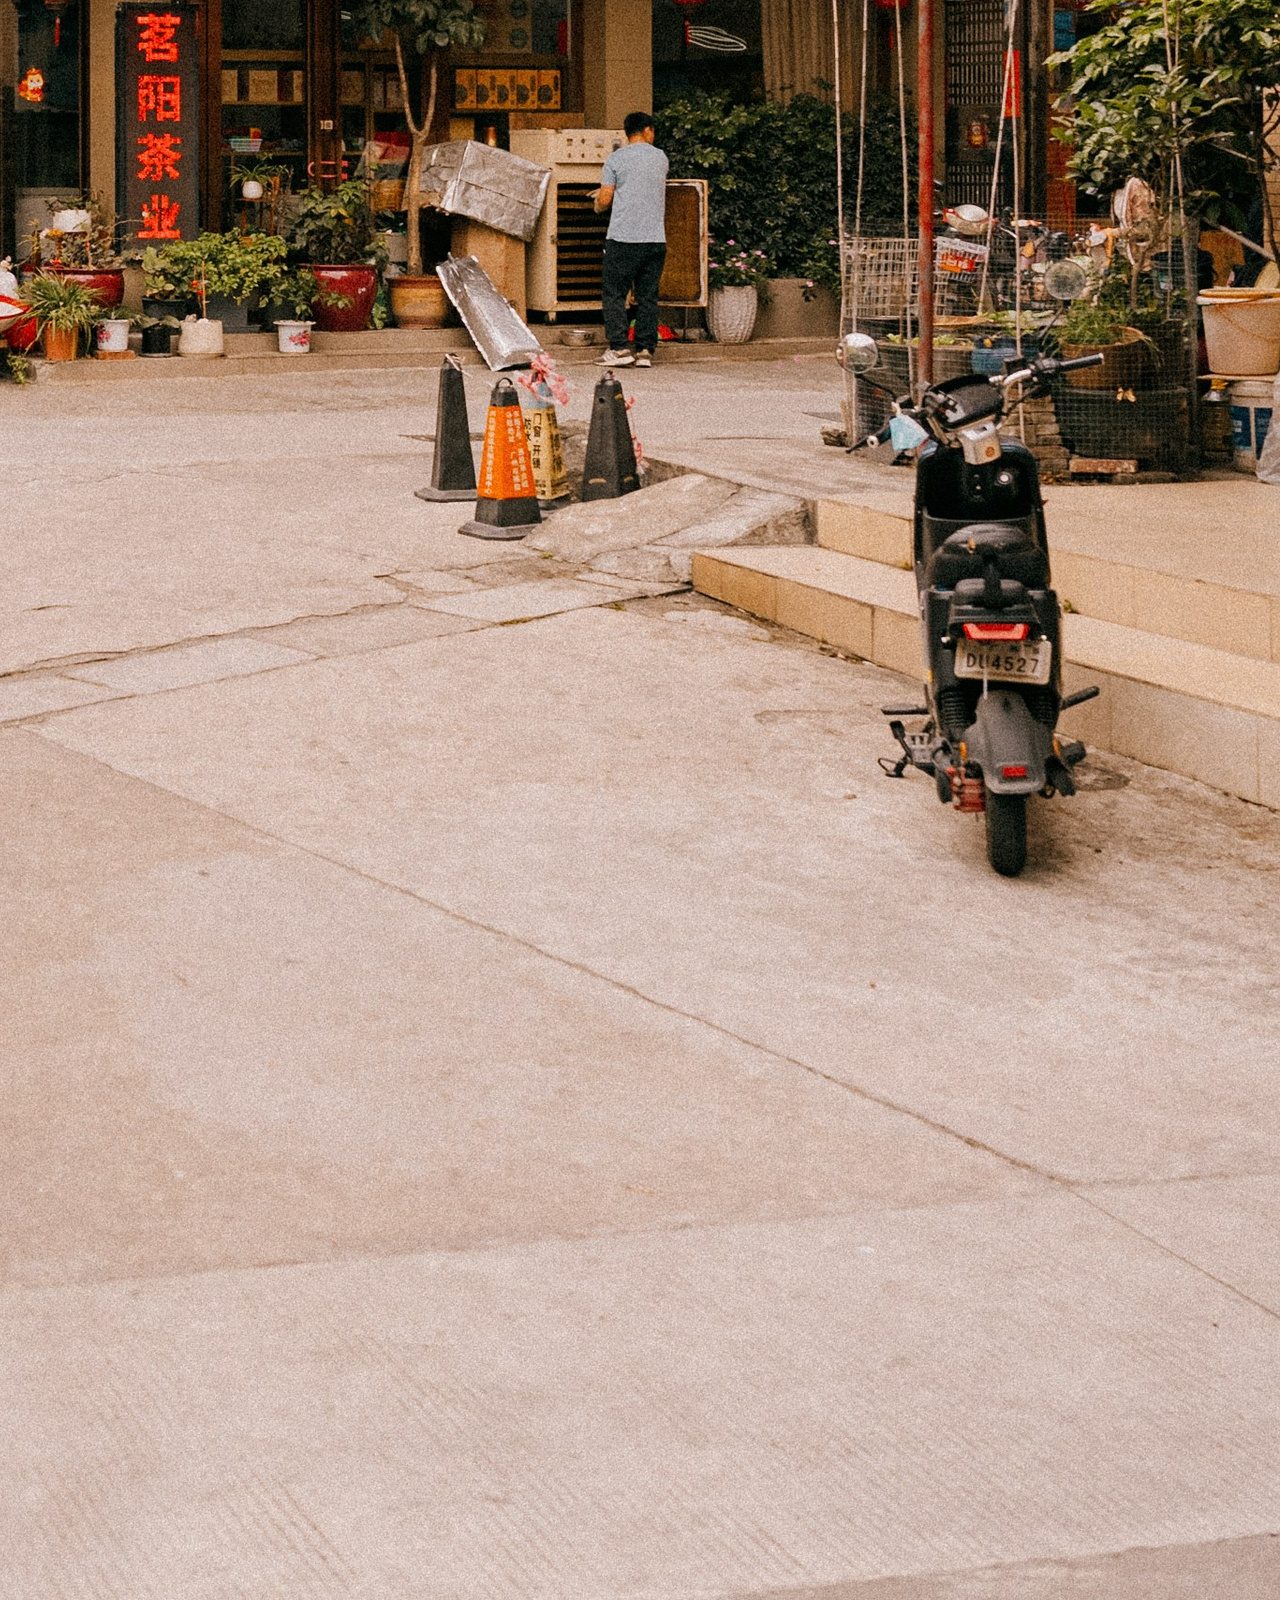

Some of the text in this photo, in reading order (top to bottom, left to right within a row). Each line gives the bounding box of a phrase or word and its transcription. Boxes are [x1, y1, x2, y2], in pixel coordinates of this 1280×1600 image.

[137, 13, 182, 239] 茗阳茶业
[966, 653, 1040, 674] DU4527
